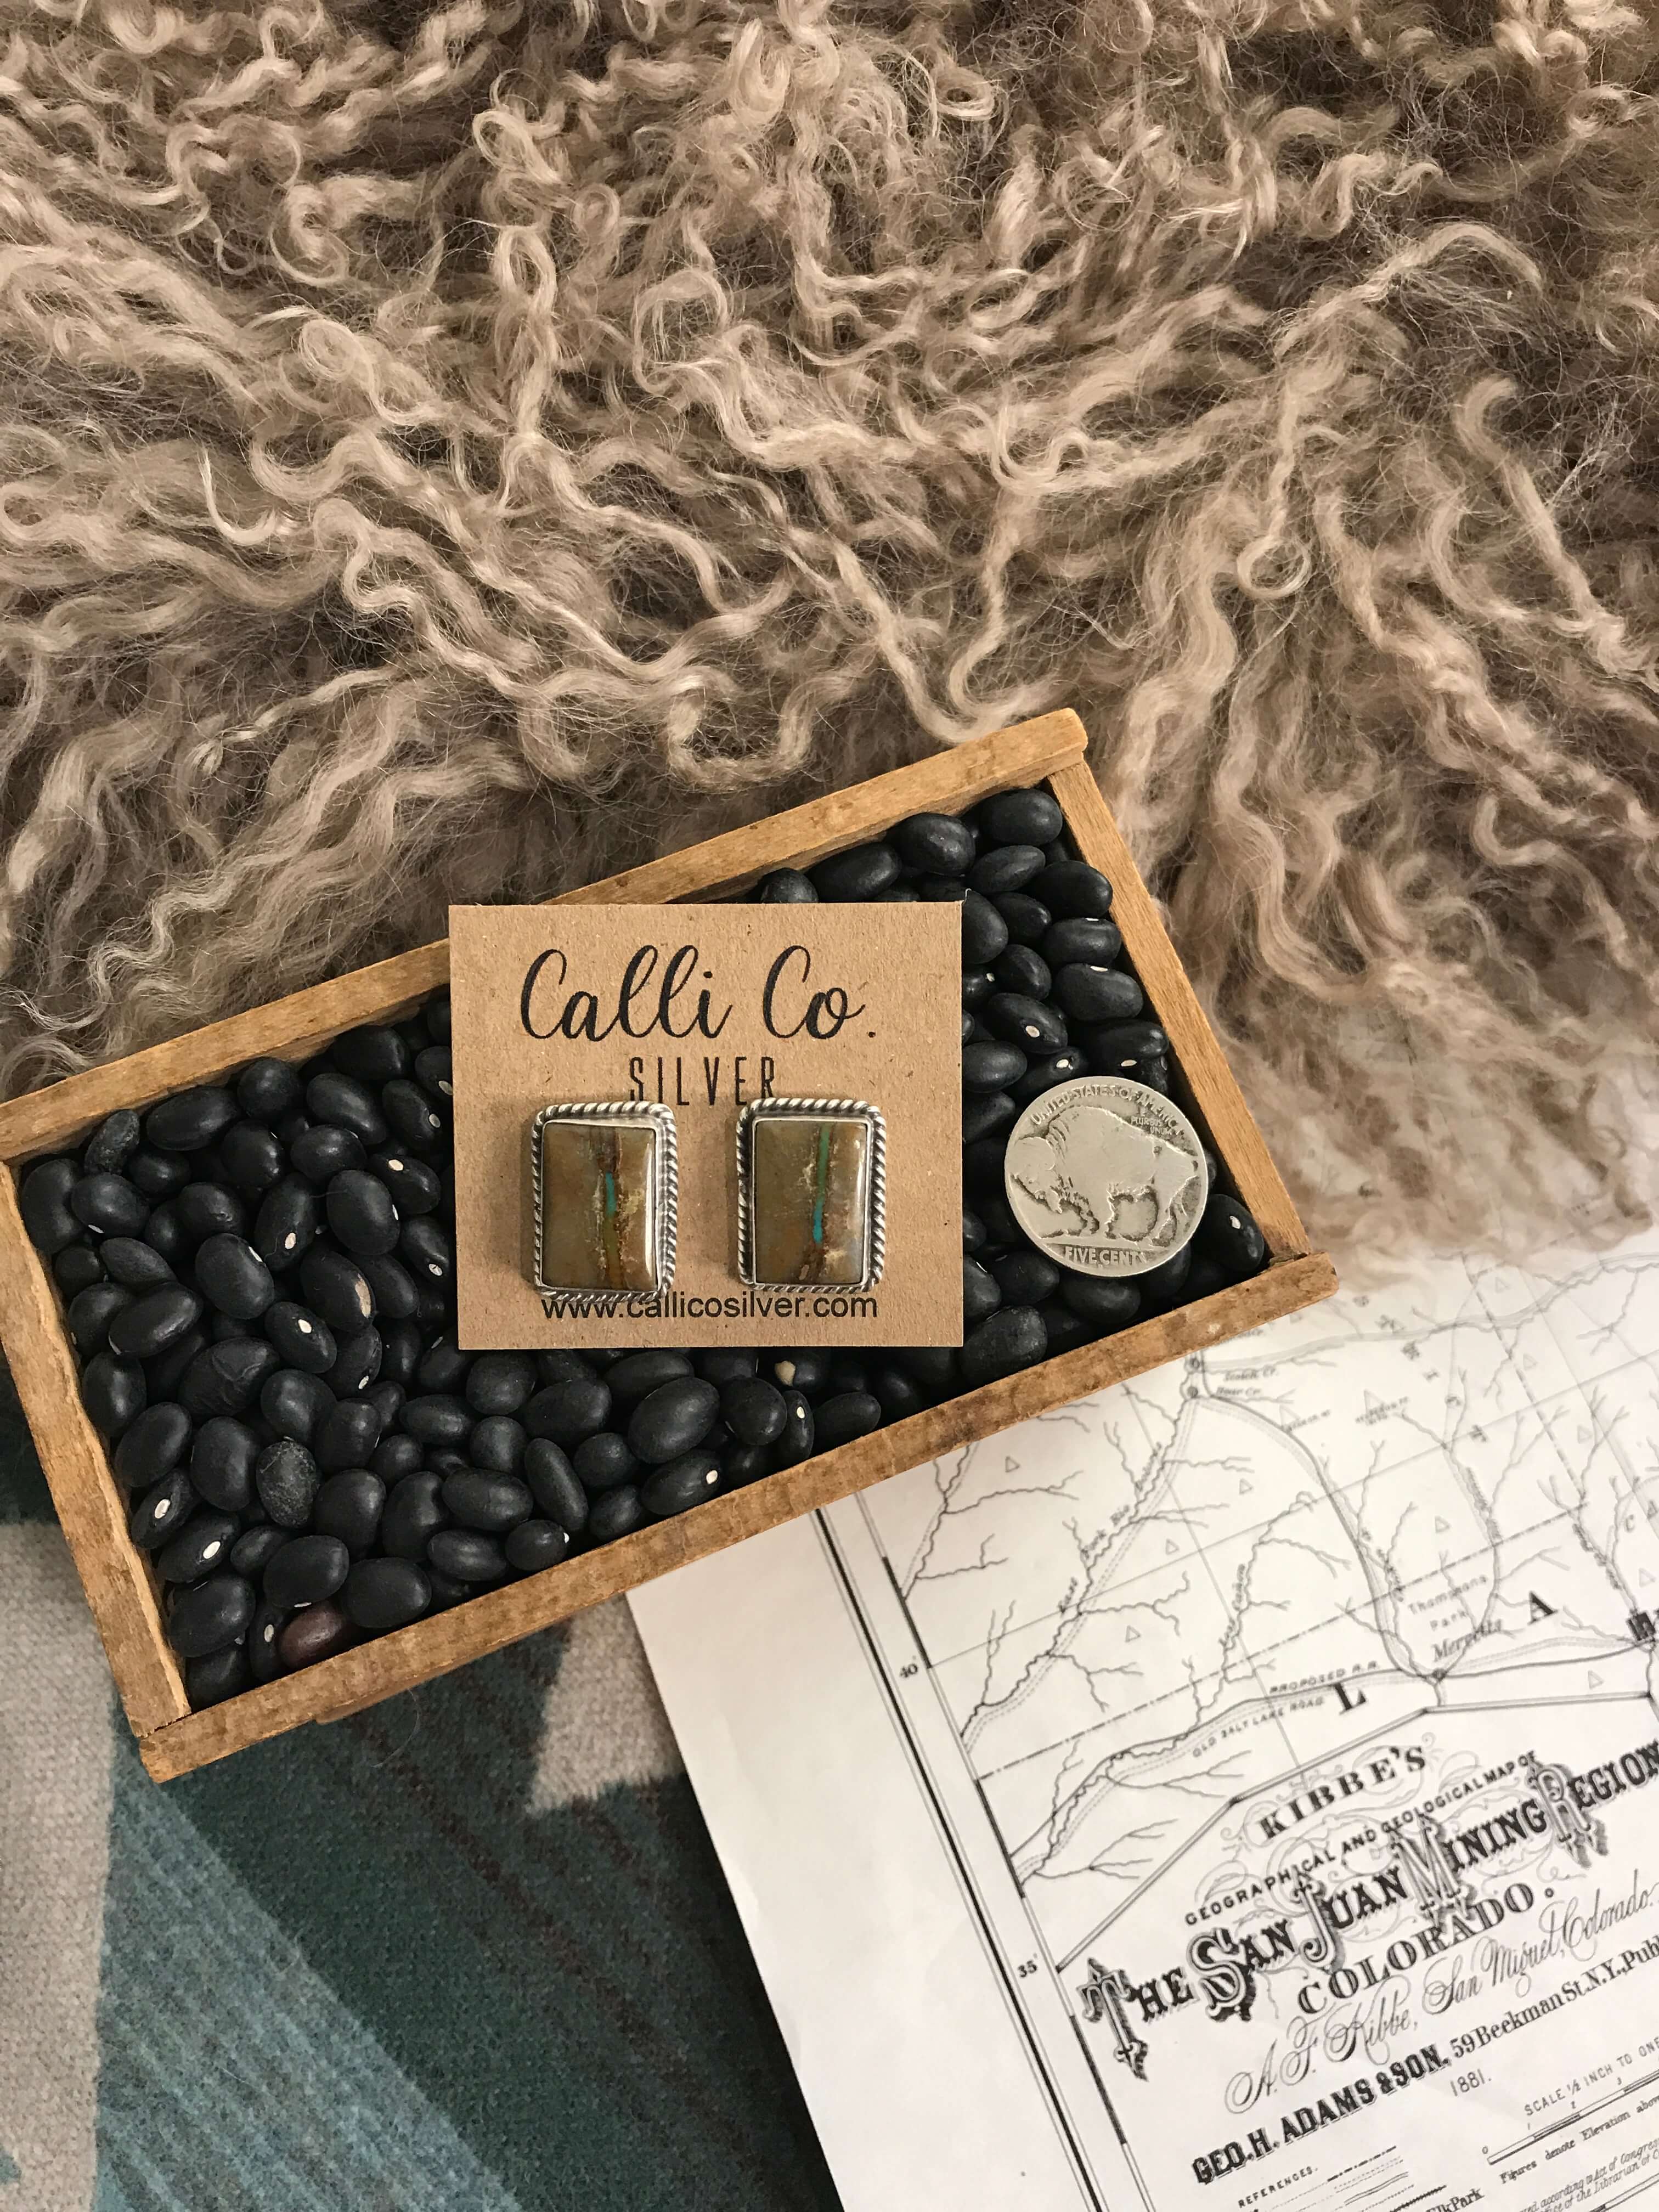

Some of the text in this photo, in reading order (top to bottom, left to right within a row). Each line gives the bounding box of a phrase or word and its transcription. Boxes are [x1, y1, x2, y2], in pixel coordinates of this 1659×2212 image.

[520, 945, 876, 1042] Calli Co.
[629, 1056, 775, 1106] SILVER
[1069, 1084, 1116, 1099] STATES
[1064, 1245, 1148, 1267] FIVE CENTS
[541, 1291, 878, 1319] www.callicosilver.com
[1269, 1667, 1346, 1695] PROPOSED
[1257, 1745, 1426, 1839] KIBBE'S
[1184, 1849, 1336, 1926] GEOGRAPHICAL
[1339, 1827, 1378, 1855] AND
[1380, 1777, 1484, 1835] GEOLOGICAL
[1482, 1760, 1516, 1784] MAP
[1186, 1918, 1301, 2024] SAN
[1381, 1797, 1549, 1931] MINING
[1421, 1954, 1484, 2016] San
[1280, 2077, 1378, 2145] ADAMS
[1450, 2033, 1477, 2059] 59
[1471, 1993, 1566, 2049] Beekman
[1450, 2069, 1492, 2097] 1881.
[1523, 2087, 1566, 2116] SCALE
[1583, 2064, 1613, 2086] INCH
[1616, 2053, 1633, 2067] TO
[1499, 2159, 1538, 2185] Figures
[1544, 2138, 1576, 2160] denote
[1578, 2111, 1632, 2141] Elevation
[1609, 2155, 1618, 2171] of
[1238, 2165, 1319, 2208] REFERENCES.
[1448, 2188, 1485, 2212] Park
